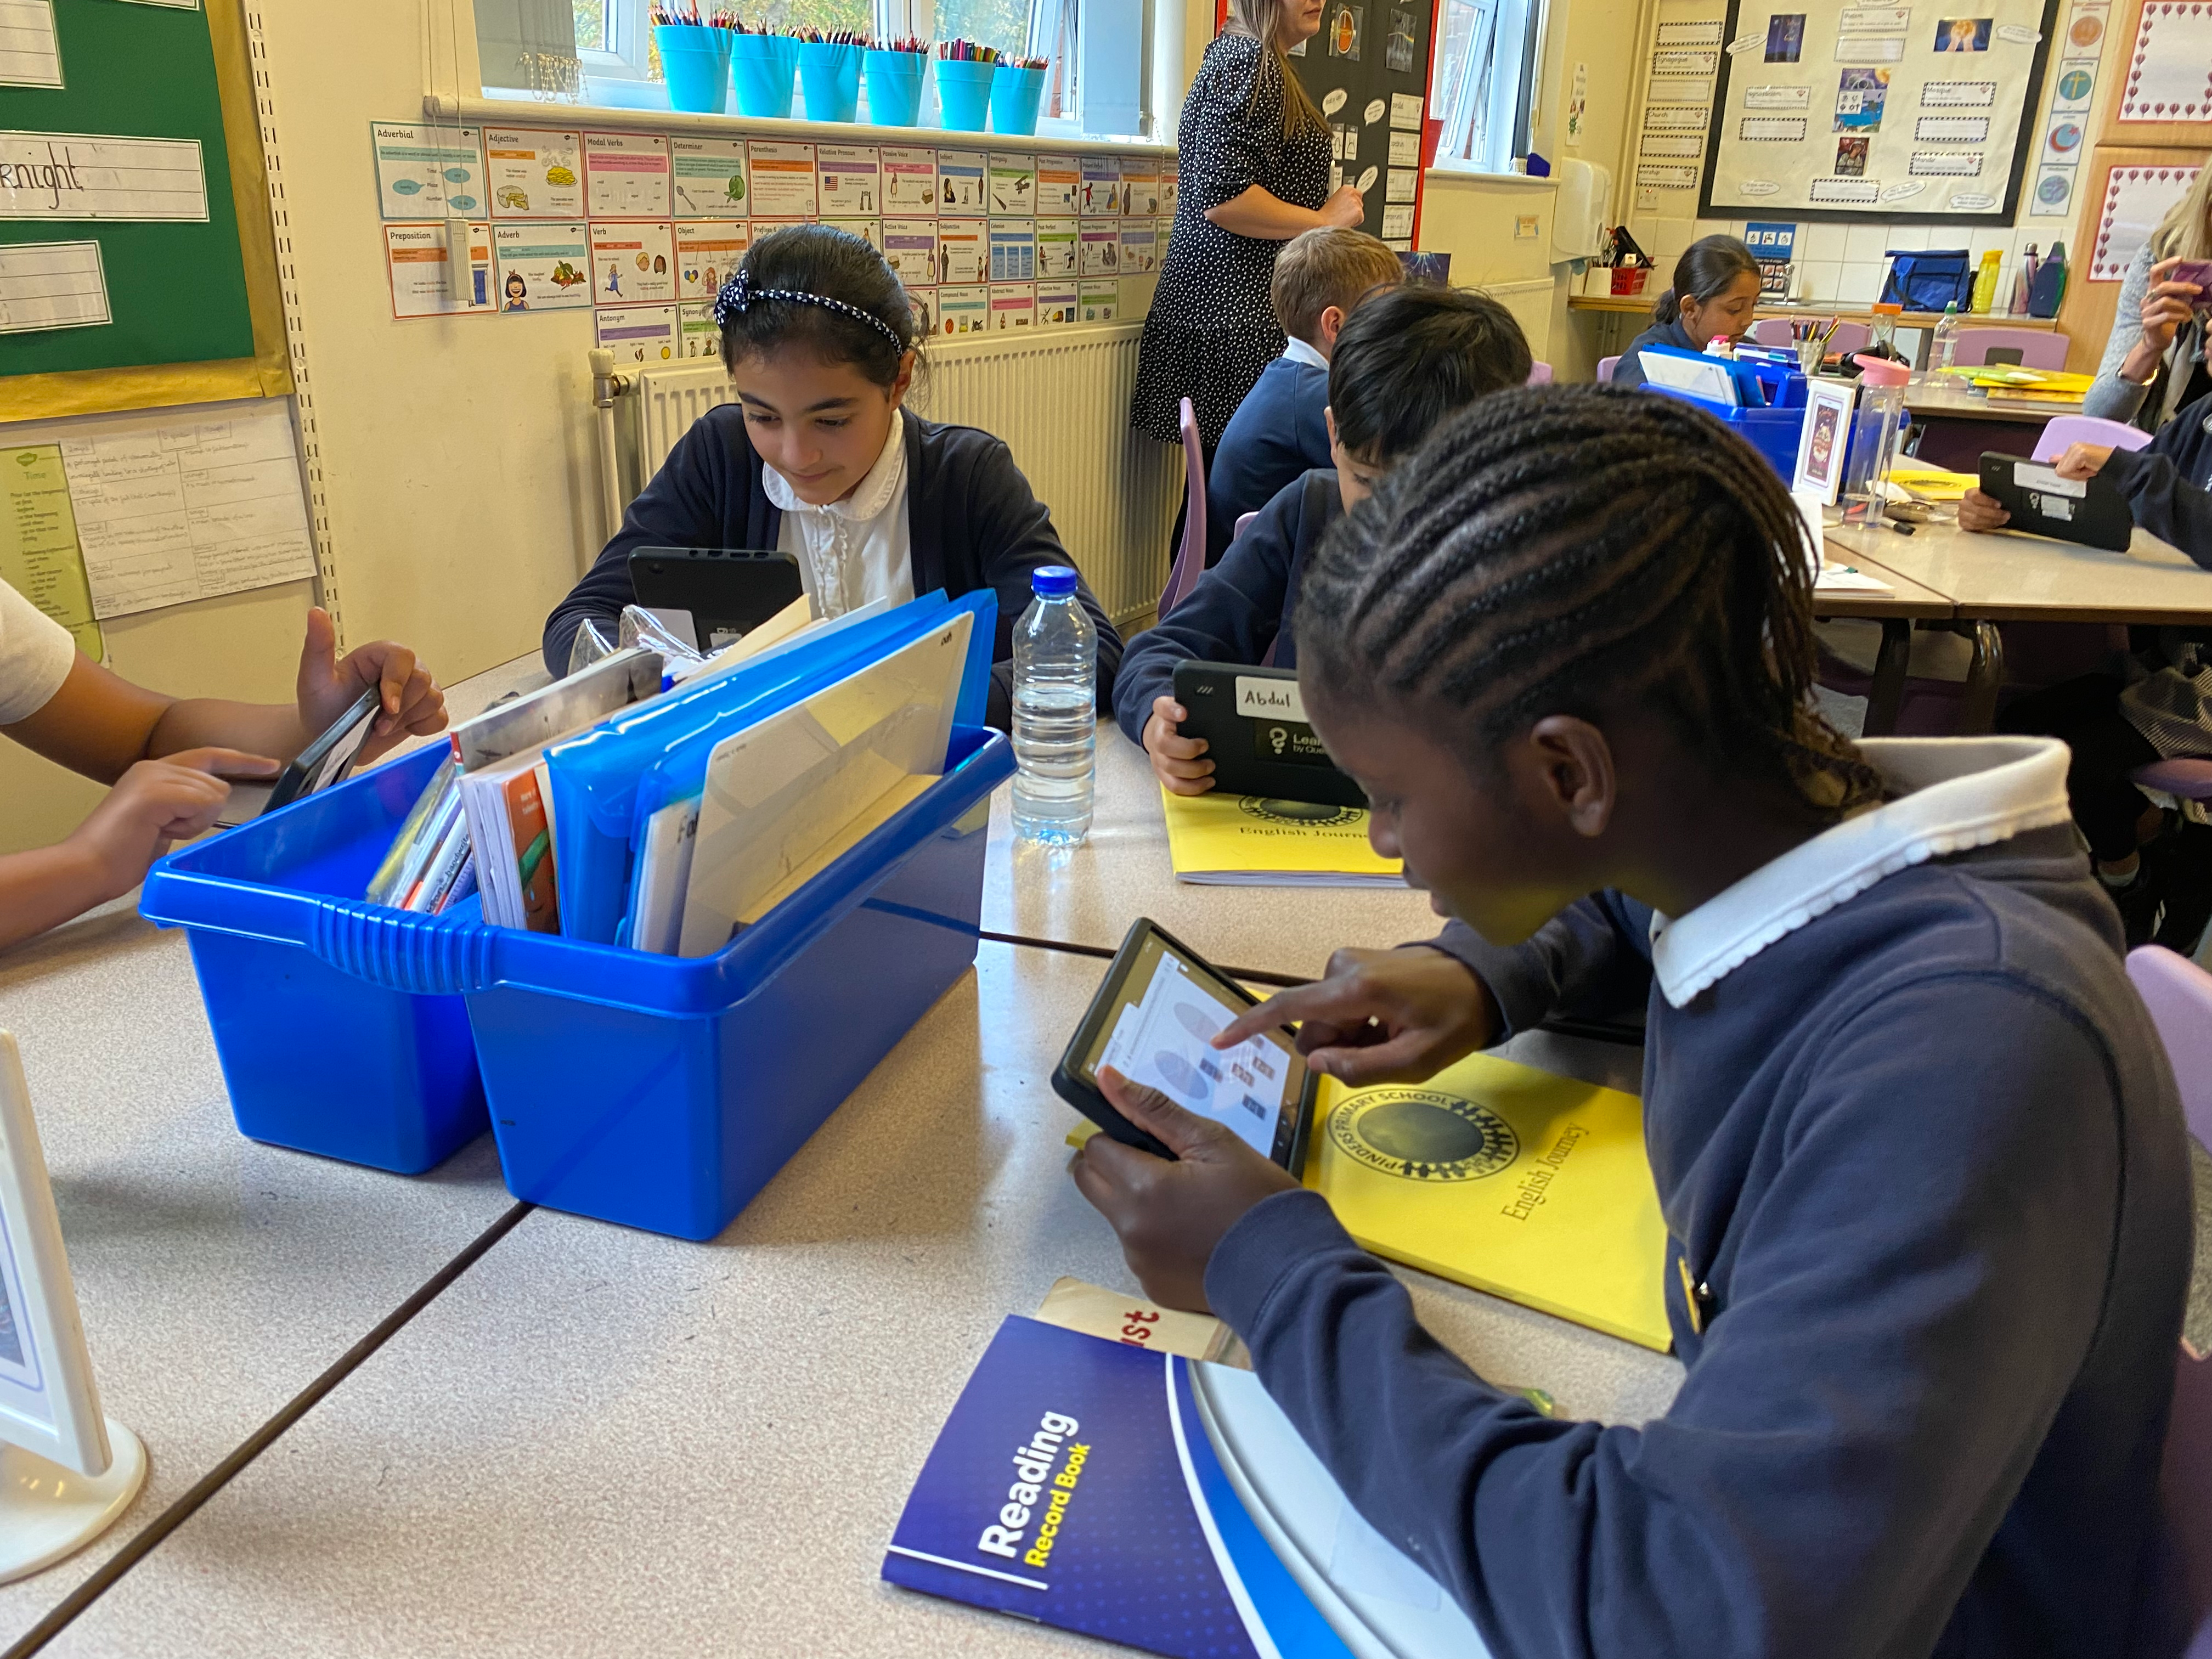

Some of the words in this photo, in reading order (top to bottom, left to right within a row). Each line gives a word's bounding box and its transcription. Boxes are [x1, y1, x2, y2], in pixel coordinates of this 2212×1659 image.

[1657, 56, 1688, 64] Synagogue
[377, 129, 414, 139] Adverbial
[489, 134, 519, 144] Adjective
[390, 232, 431, 241] Preposition
[678, 227, 695, 235] Object
[599, 314, 625, 323] Antonym
[1244, 690, 1290, 708] Abdul
[1293, 733, 1322, 746] Lear
[1293, 744, 1305, 753] by
[1305, 746, 1325, 755] Que
[1240, 827, 1307, 836] English
[1313, 830, 1368, 839] Journ
[1378, 1091, 1449, 1107] SCHOOL
[1335, 1095, 1376, 1131] PRIMARY
[1338, 1132, 1398, 1170] PINDERS
[1500, 1170, 1554, 1221] English
[1535, 1122, 1590, 1171] Journey
[978, 1410, 1079, 1558] Reading
[1024, 1487, 1069, 1567] Record
[1058, 1442, 1091, 1489] Book
